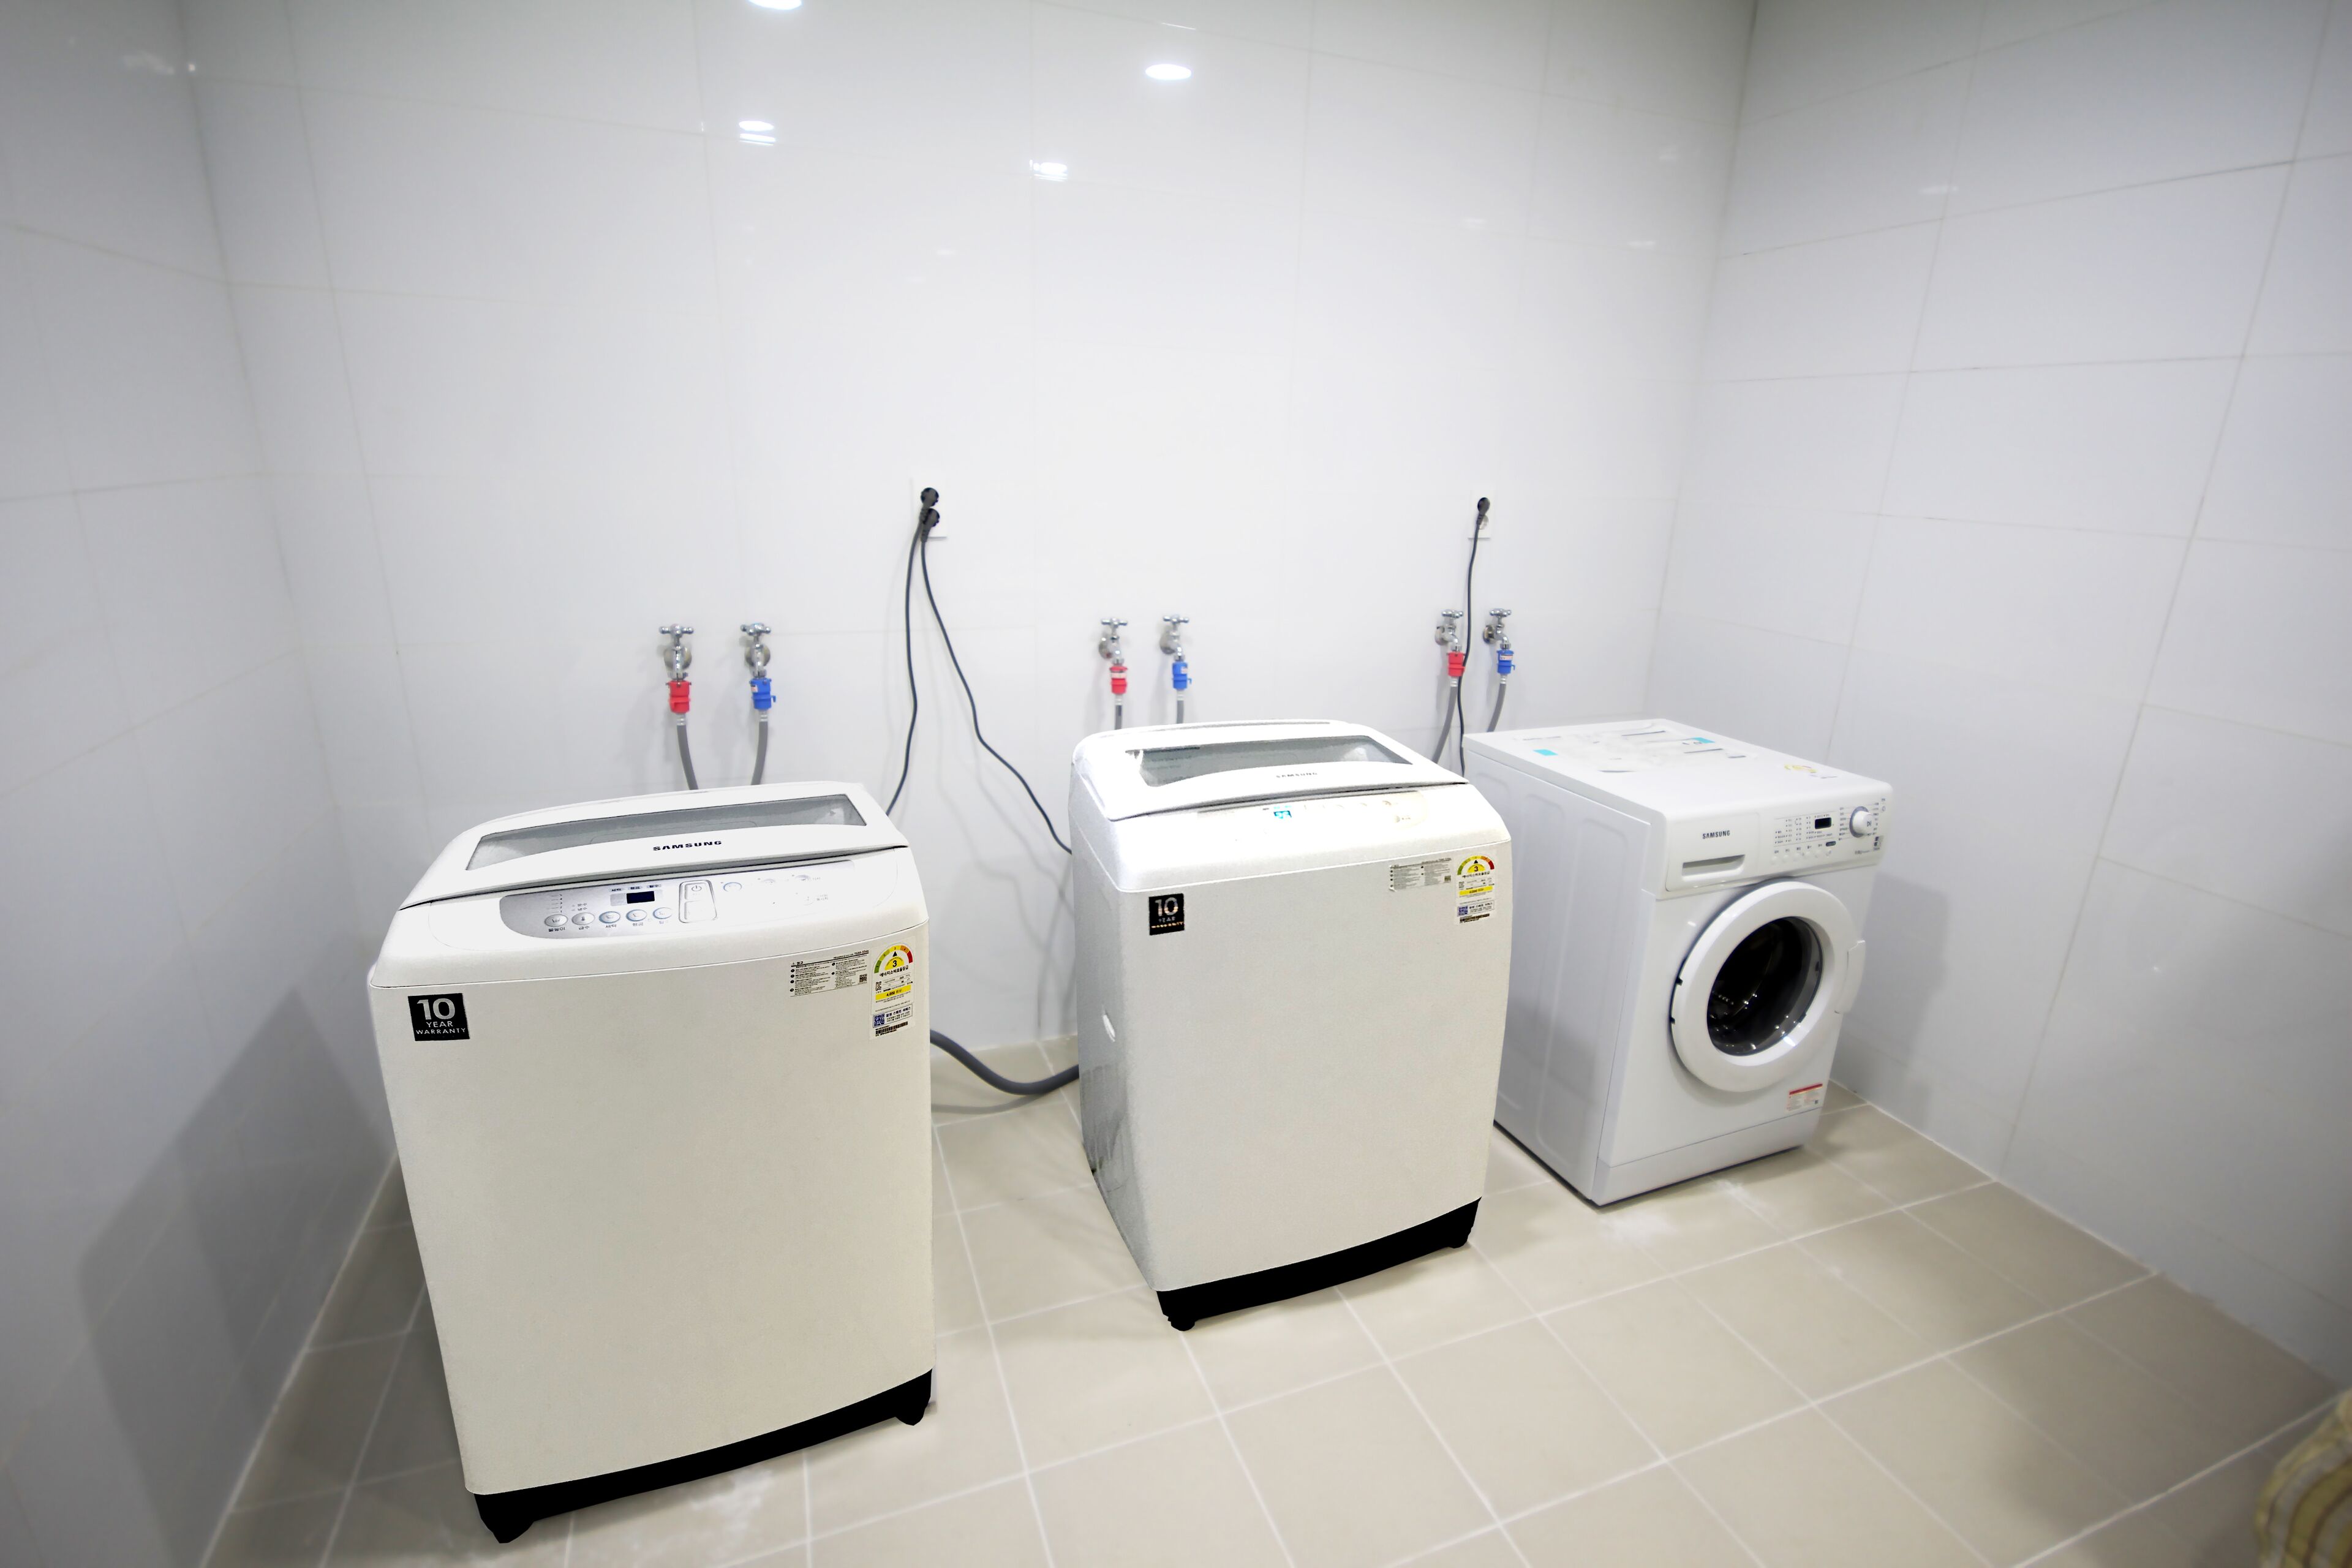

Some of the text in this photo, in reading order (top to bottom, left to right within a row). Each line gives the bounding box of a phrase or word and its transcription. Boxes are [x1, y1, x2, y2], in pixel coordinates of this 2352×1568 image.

[1702, 830, 1730, 839] SAMSUNG
[653, 841, 722, 850] SAMSUNG
[1155, 897, 1178, 917] 10
[417, 998, 456, 1020] 10
